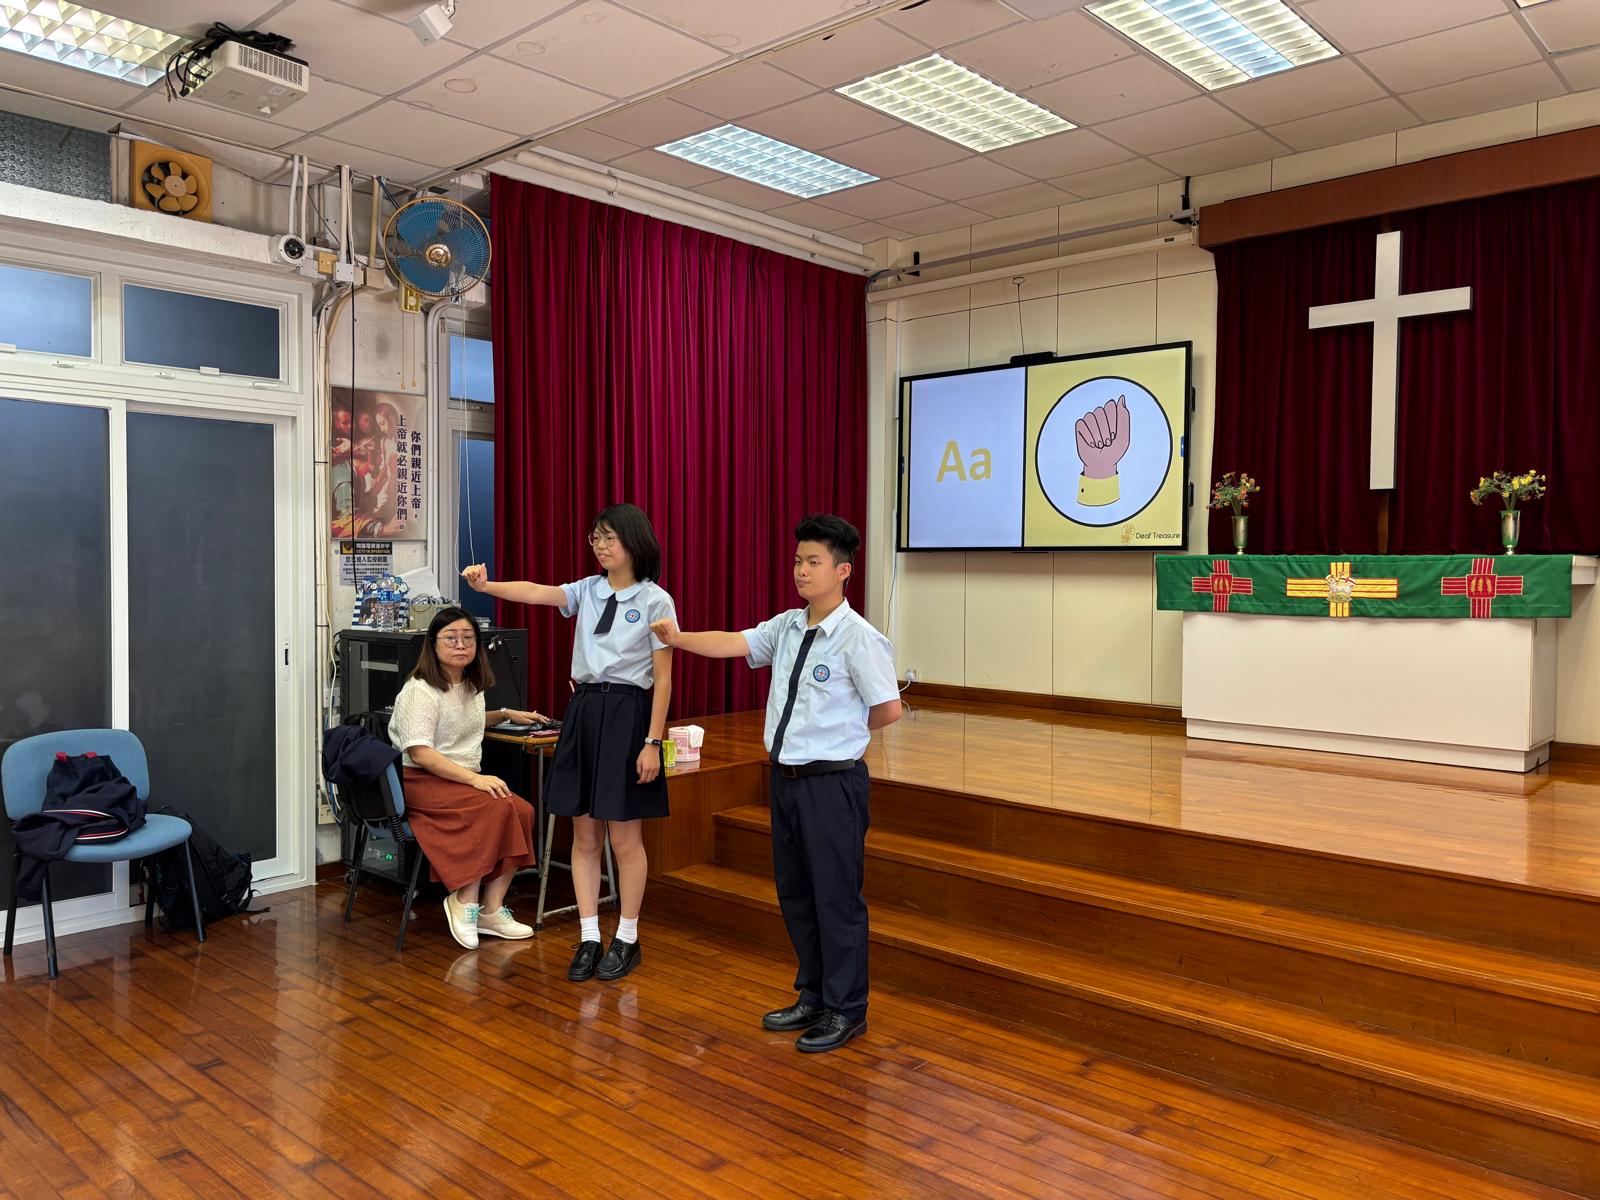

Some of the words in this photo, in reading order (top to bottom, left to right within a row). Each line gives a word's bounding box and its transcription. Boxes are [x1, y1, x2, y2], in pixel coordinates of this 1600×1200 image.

[397, 414, 407, 530] 上帝就必親近你們。
[411, 430, 421, 519] 你們親近上帝，
[936, 440, 992, 482] Aa
